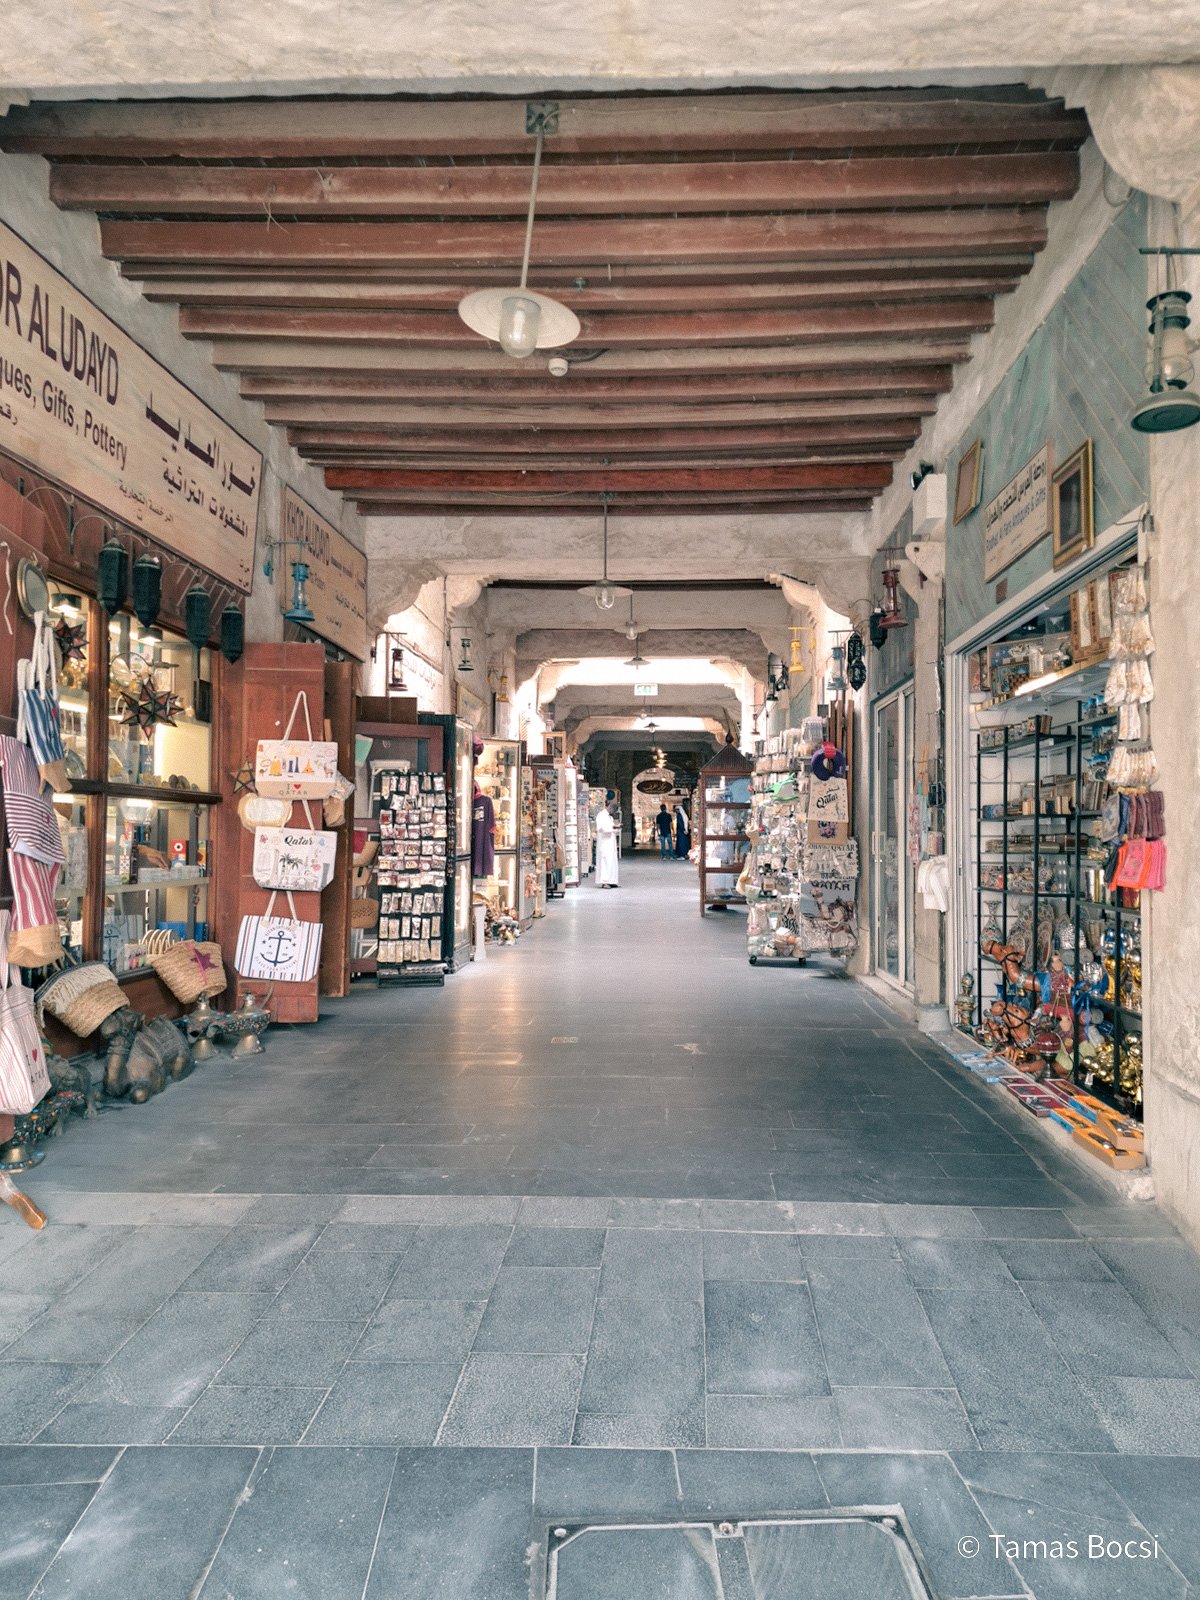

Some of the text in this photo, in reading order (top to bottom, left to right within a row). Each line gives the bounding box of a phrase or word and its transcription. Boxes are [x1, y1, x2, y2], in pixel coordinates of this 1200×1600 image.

[0, 258, 119, 406] R AL UDAYD
[42, 380, 79, 436] Gifts,
[84, 409, 128, 471] Pottery
[816, 792, 839, 808] Qatar
[284, 834, 313, 847] Qatar
